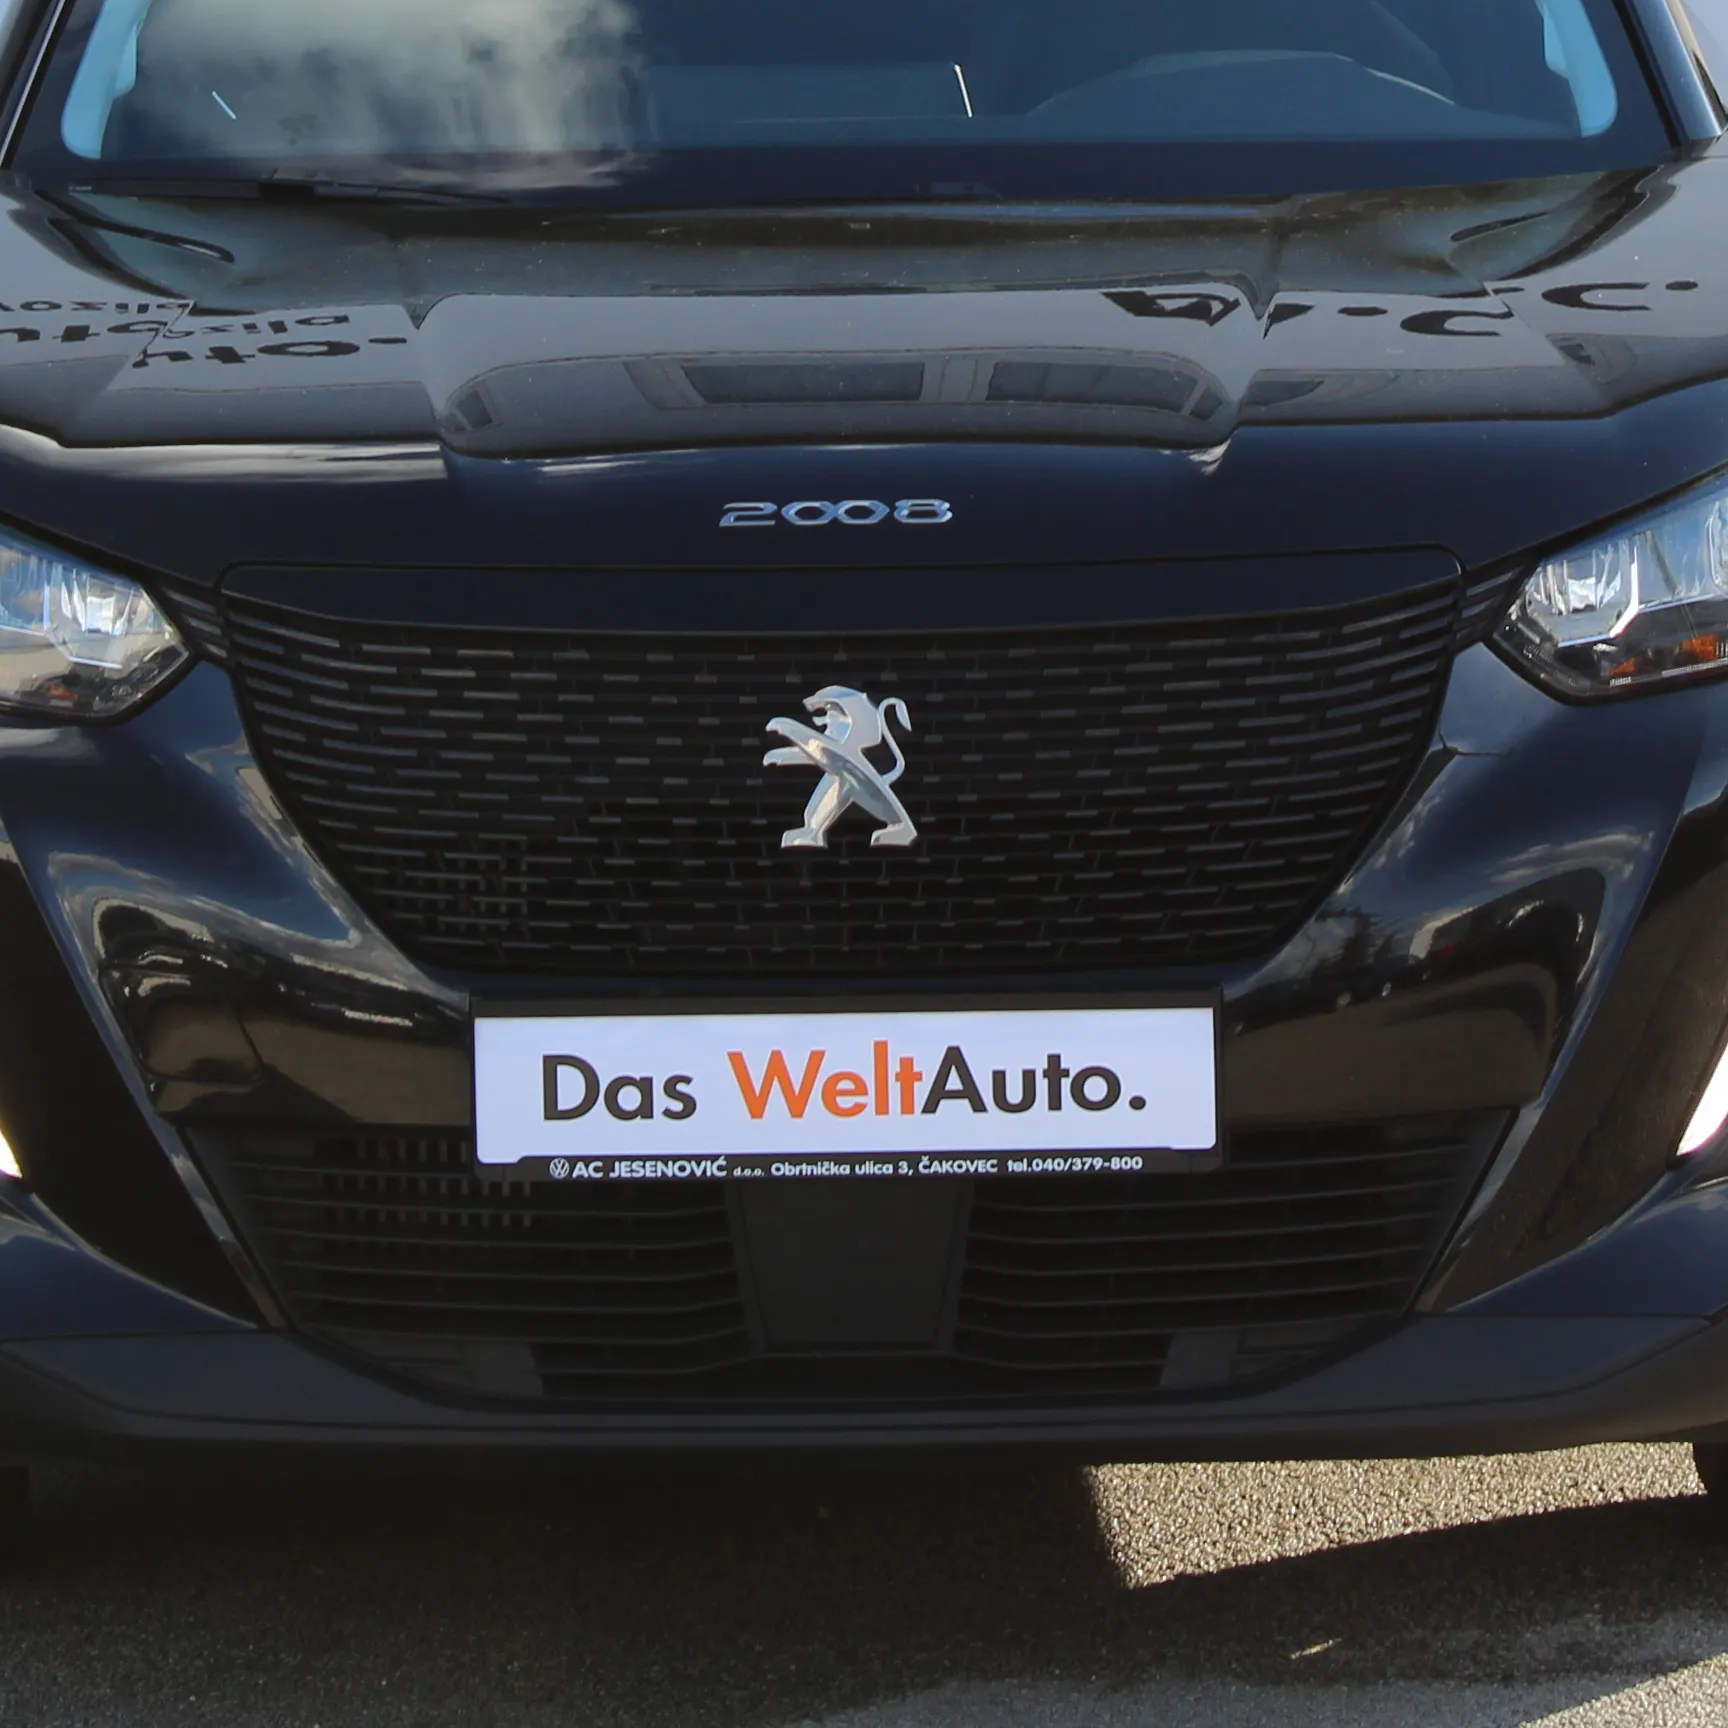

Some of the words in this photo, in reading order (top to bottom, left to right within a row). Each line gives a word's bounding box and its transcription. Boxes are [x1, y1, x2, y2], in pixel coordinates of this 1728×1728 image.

[718, 498, 954, 527] 2008
[541, 1054, 698, 1122] Das
[726, 1039, 1148, 1121] WeltAuto.
[572, 1160, 604, 1179] AC
[608, 1155, 728, 1179] JESENOVIĆ
[770, 1161, 851, 1177] Obrtnička
[854, 1160, 894, 1176] ulica
[918, 1154, 999, 1175] ČAKOVEC
[1006, 1155, 1144, 1173] tel.040/379-800
